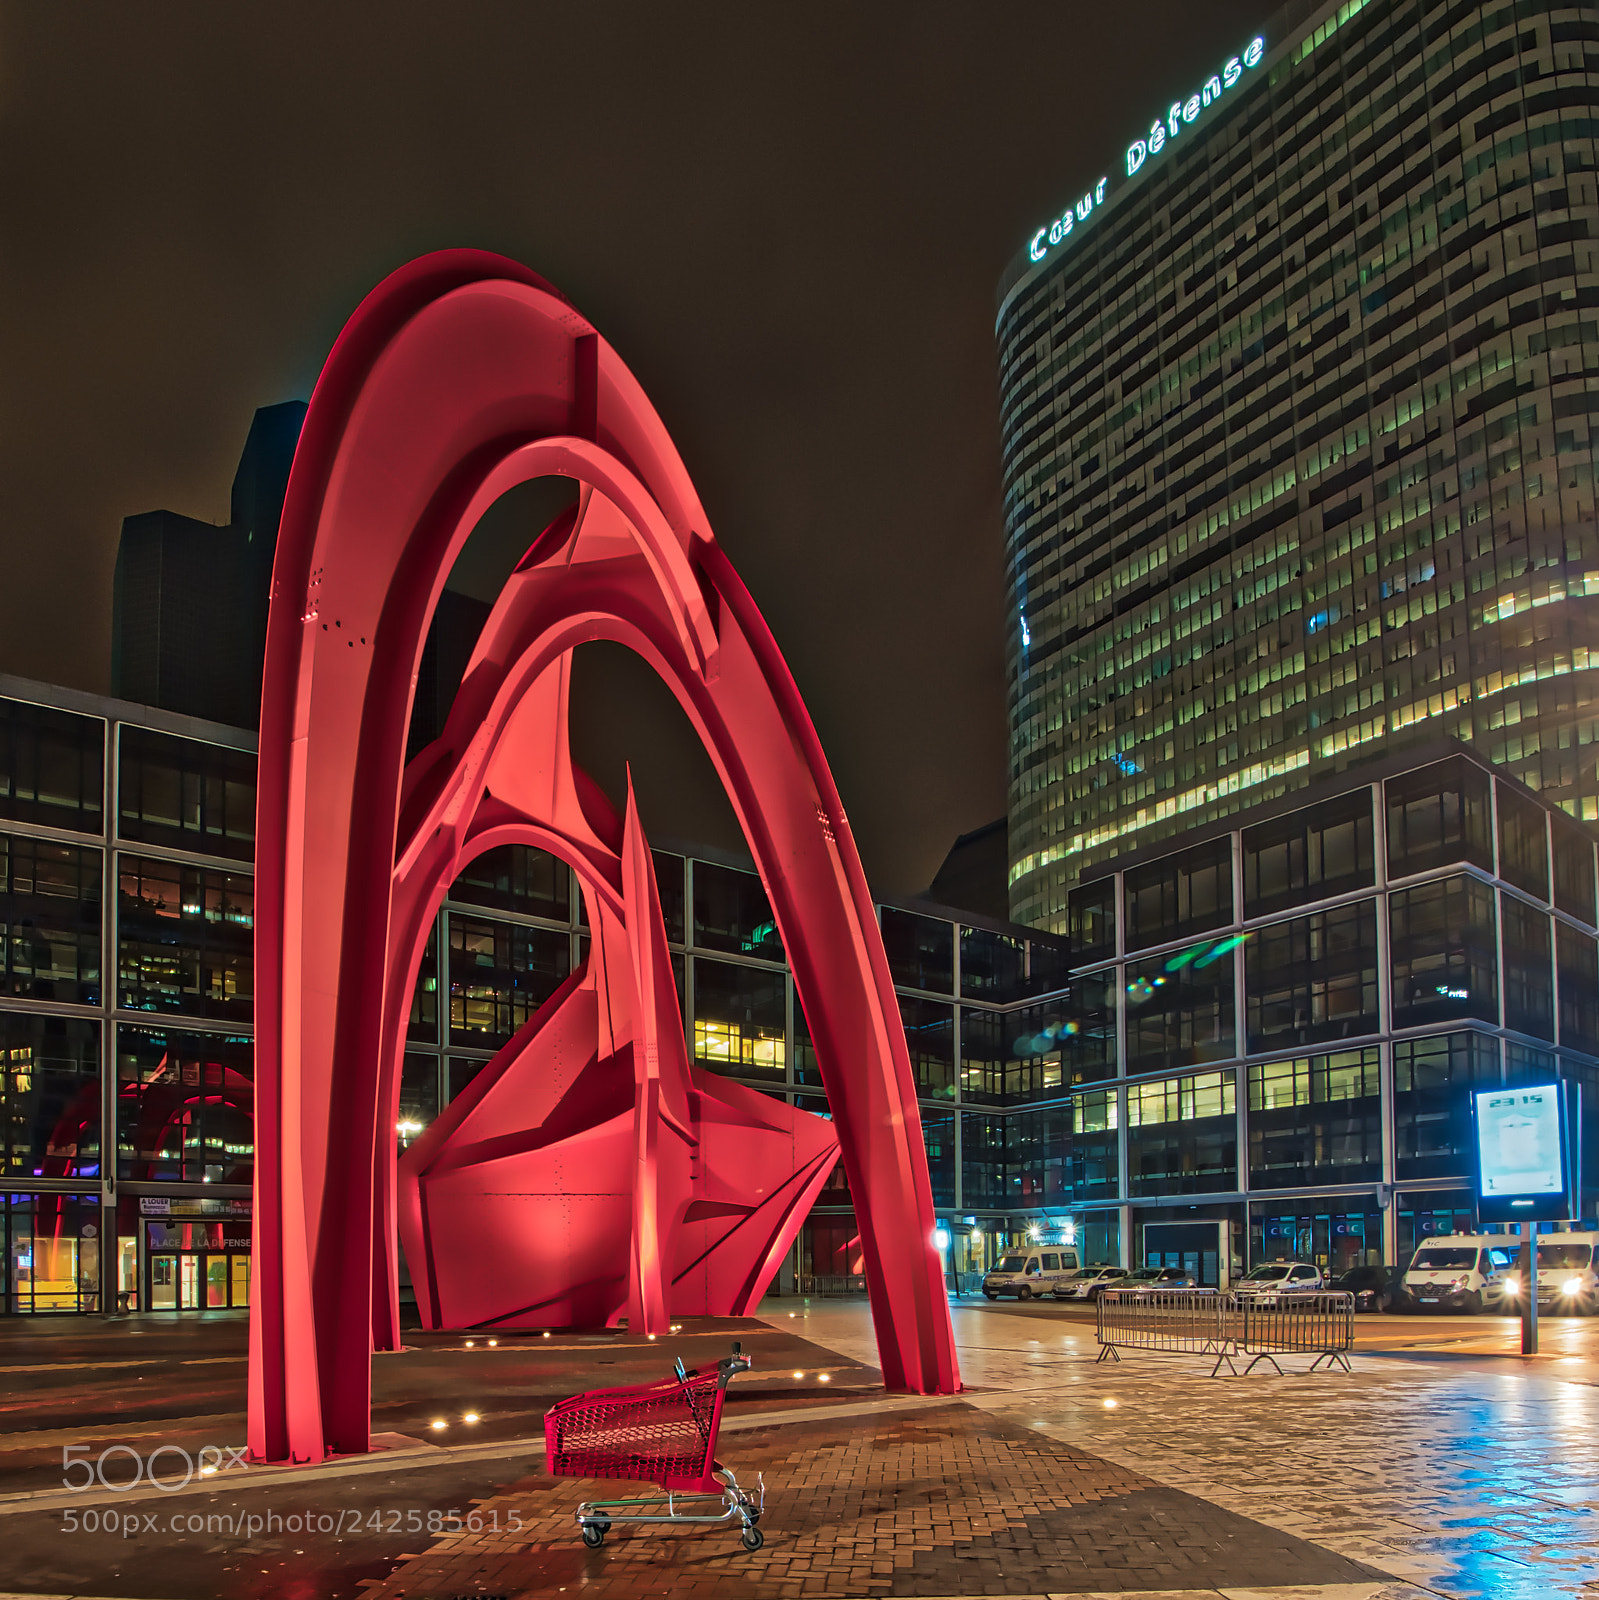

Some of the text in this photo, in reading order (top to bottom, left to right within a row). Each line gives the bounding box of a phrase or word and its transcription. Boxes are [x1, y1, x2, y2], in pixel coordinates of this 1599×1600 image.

[1030, 37, 1264, 261] Cœur Défense
[1337, 1224, 1359, 1233] CIC
[1422, 1222, 1447, 1231] CIC
[150, 1239, 181, 1247] PLACE
[197, 1239, 209, 1247] LA
